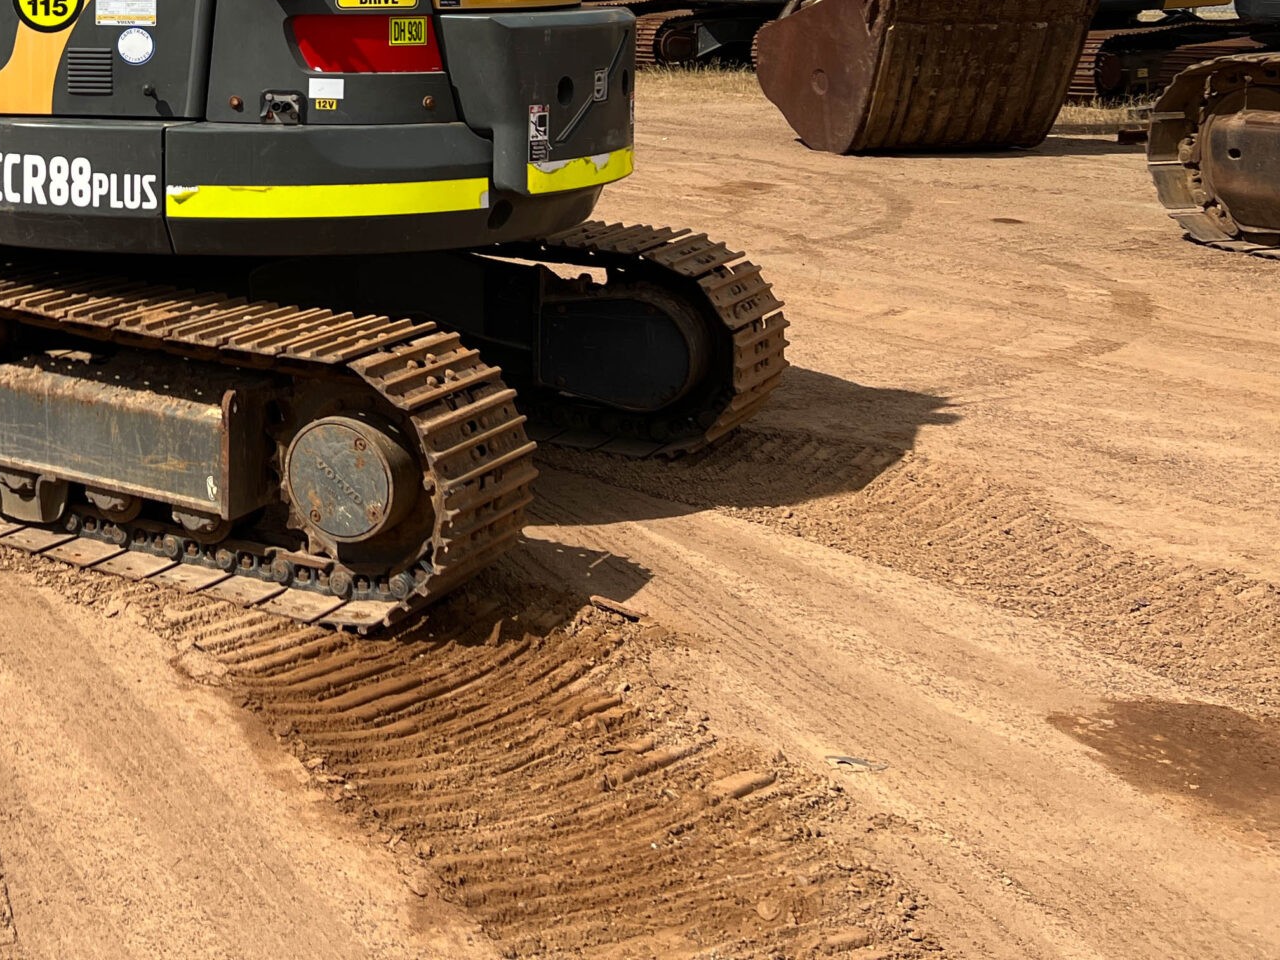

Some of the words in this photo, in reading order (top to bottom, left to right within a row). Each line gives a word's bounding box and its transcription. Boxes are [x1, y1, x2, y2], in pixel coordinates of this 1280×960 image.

[393, 21, 406, 41] DH
[408, 21, 423, 41] 930
[317, 100, 335, 109] 12V
